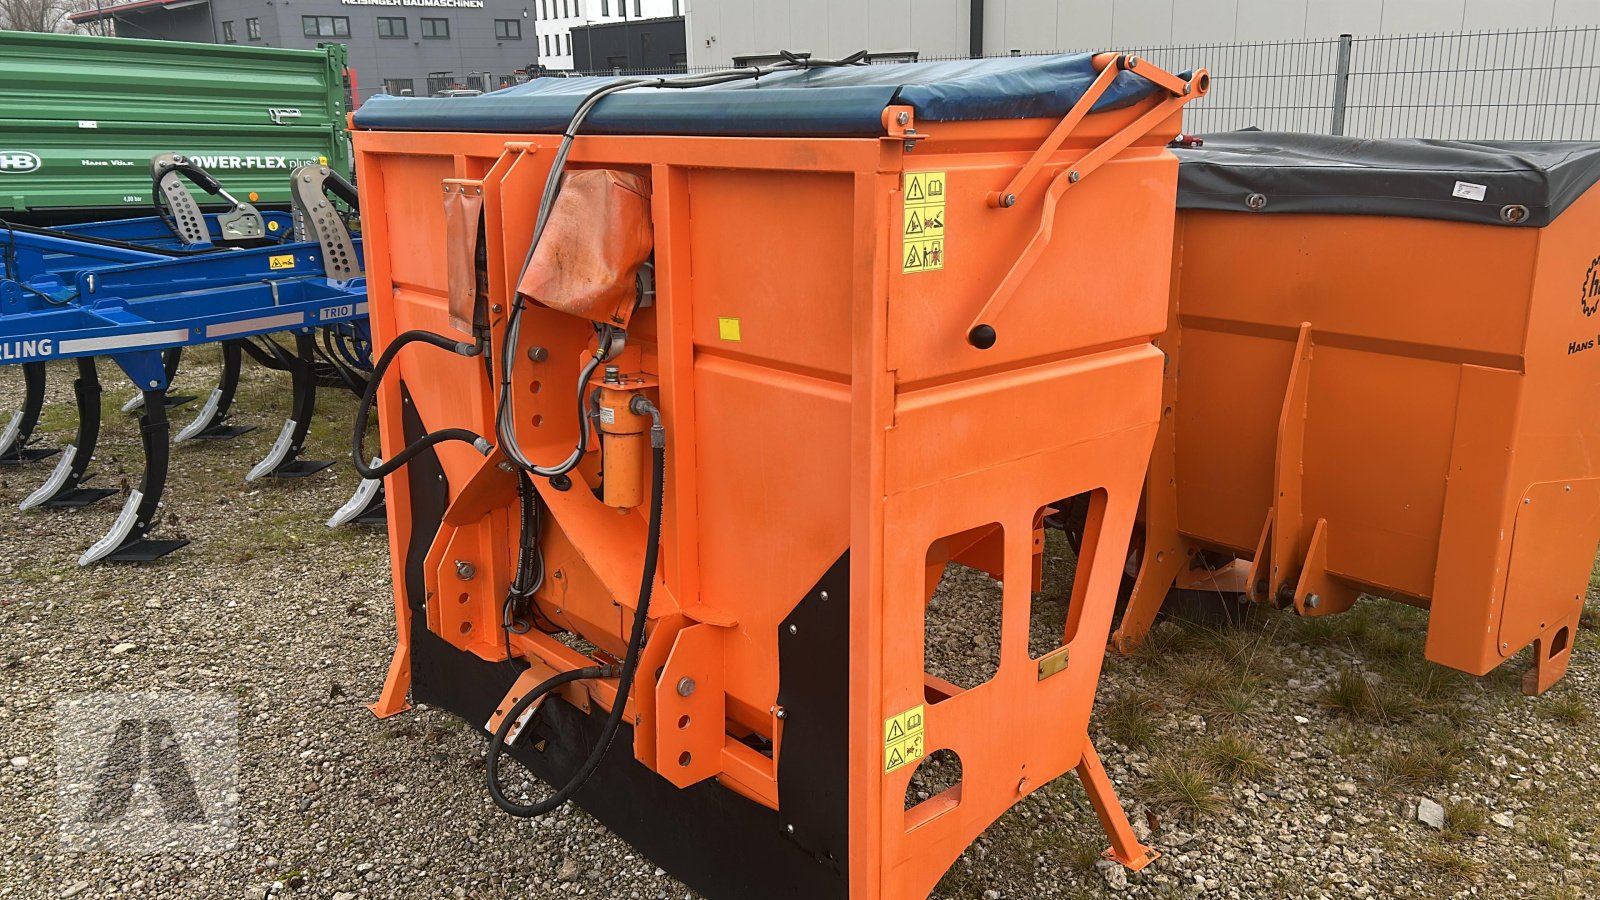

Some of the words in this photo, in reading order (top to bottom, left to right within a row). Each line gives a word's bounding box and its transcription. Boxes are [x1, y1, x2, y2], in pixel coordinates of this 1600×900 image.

[189, 156, 286, 169] OWER-FLEX
[324, 306, 349, 319] TRIO
[0, 338, 52, 360] LING
